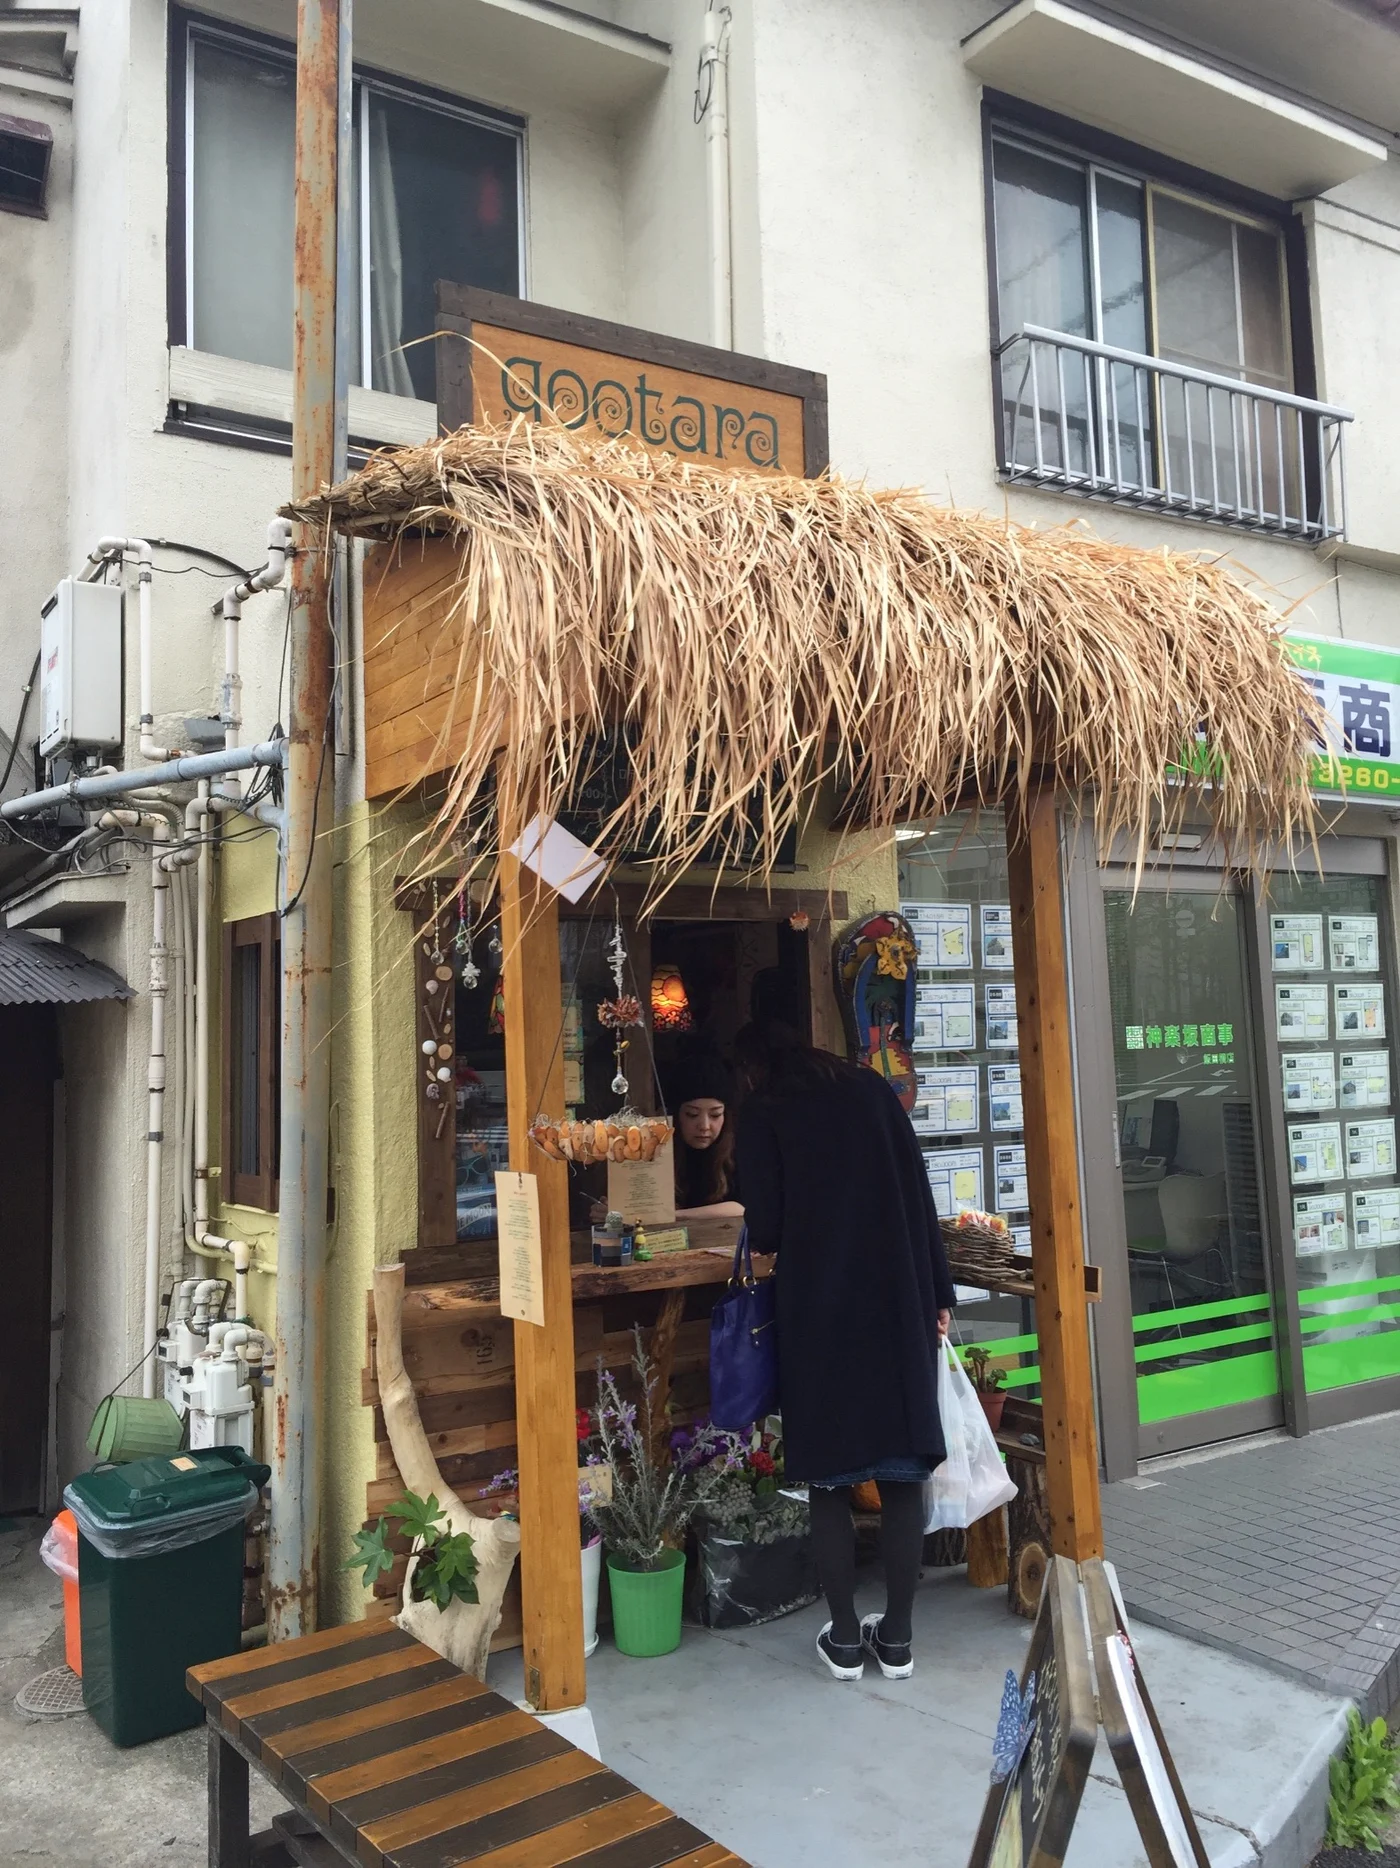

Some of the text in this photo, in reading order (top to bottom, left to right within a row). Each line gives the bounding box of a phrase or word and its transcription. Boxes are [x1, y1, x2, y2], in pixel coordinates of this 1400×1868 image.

[1146, 1023, 1233, 1048] 神楽坂商事
